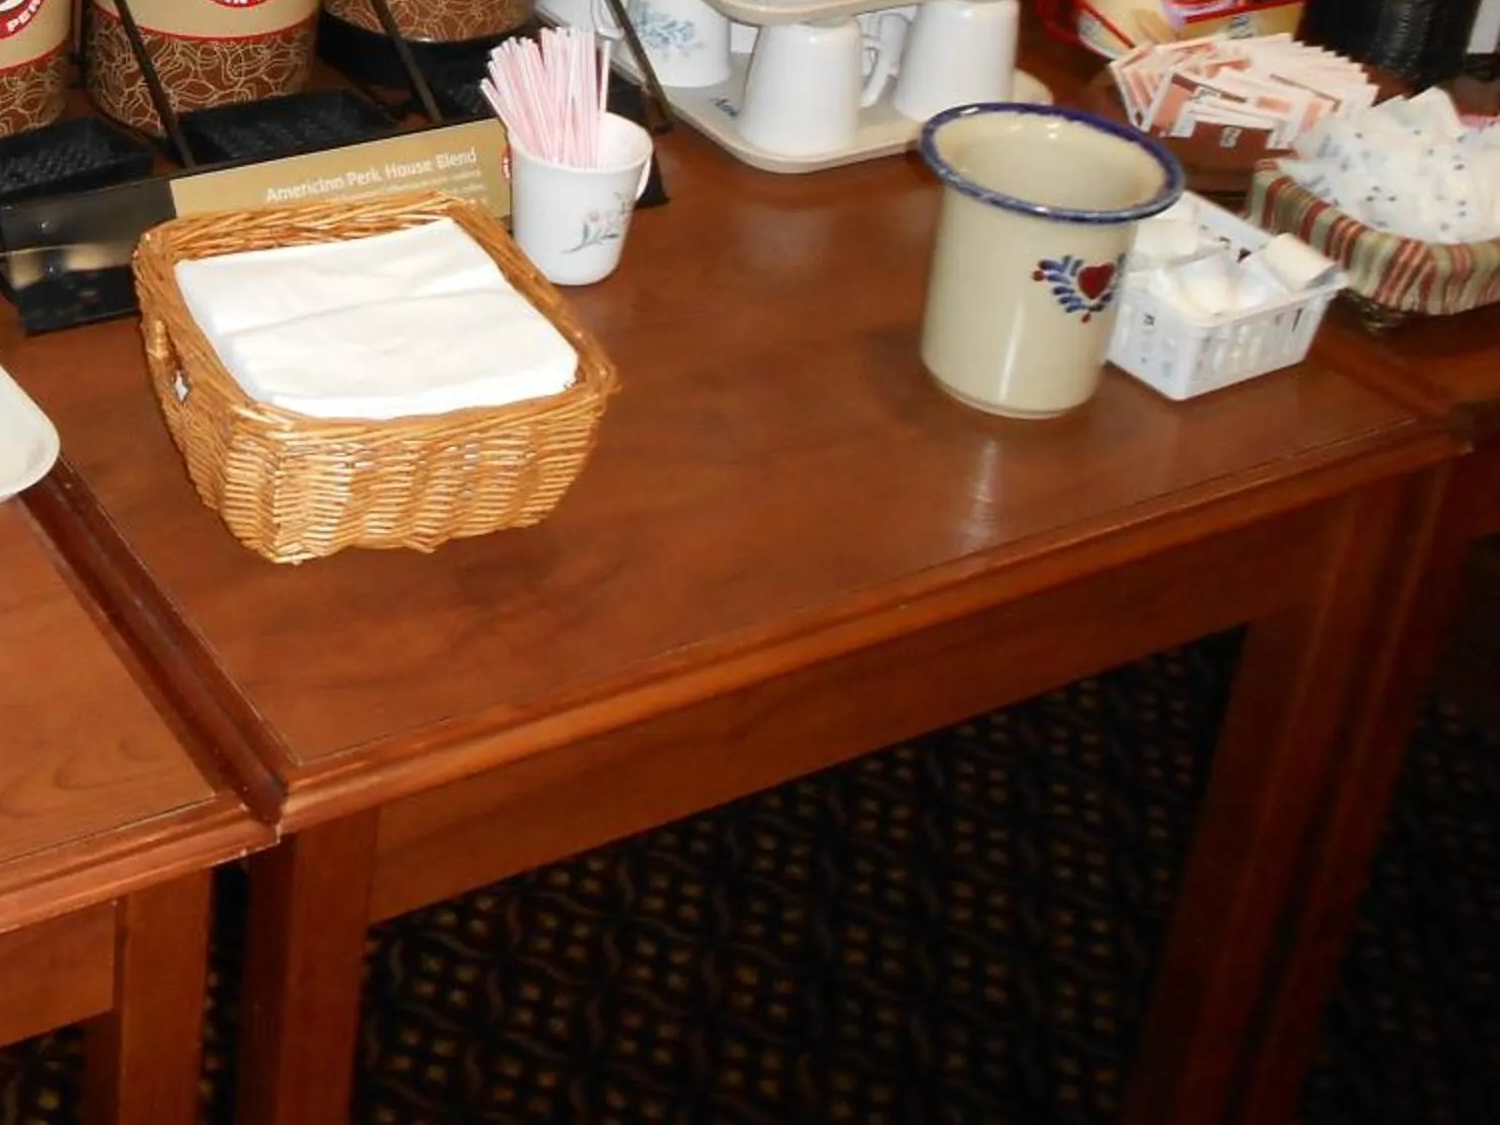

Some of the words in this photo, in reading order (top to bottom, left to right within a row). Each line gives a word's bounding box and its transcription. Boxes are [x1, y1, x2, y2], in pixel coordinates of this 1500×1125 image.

[346, 167, 383, 188] Perk
[385, 160, 433, 181] House
[435, 146, 478, 168] Blend
